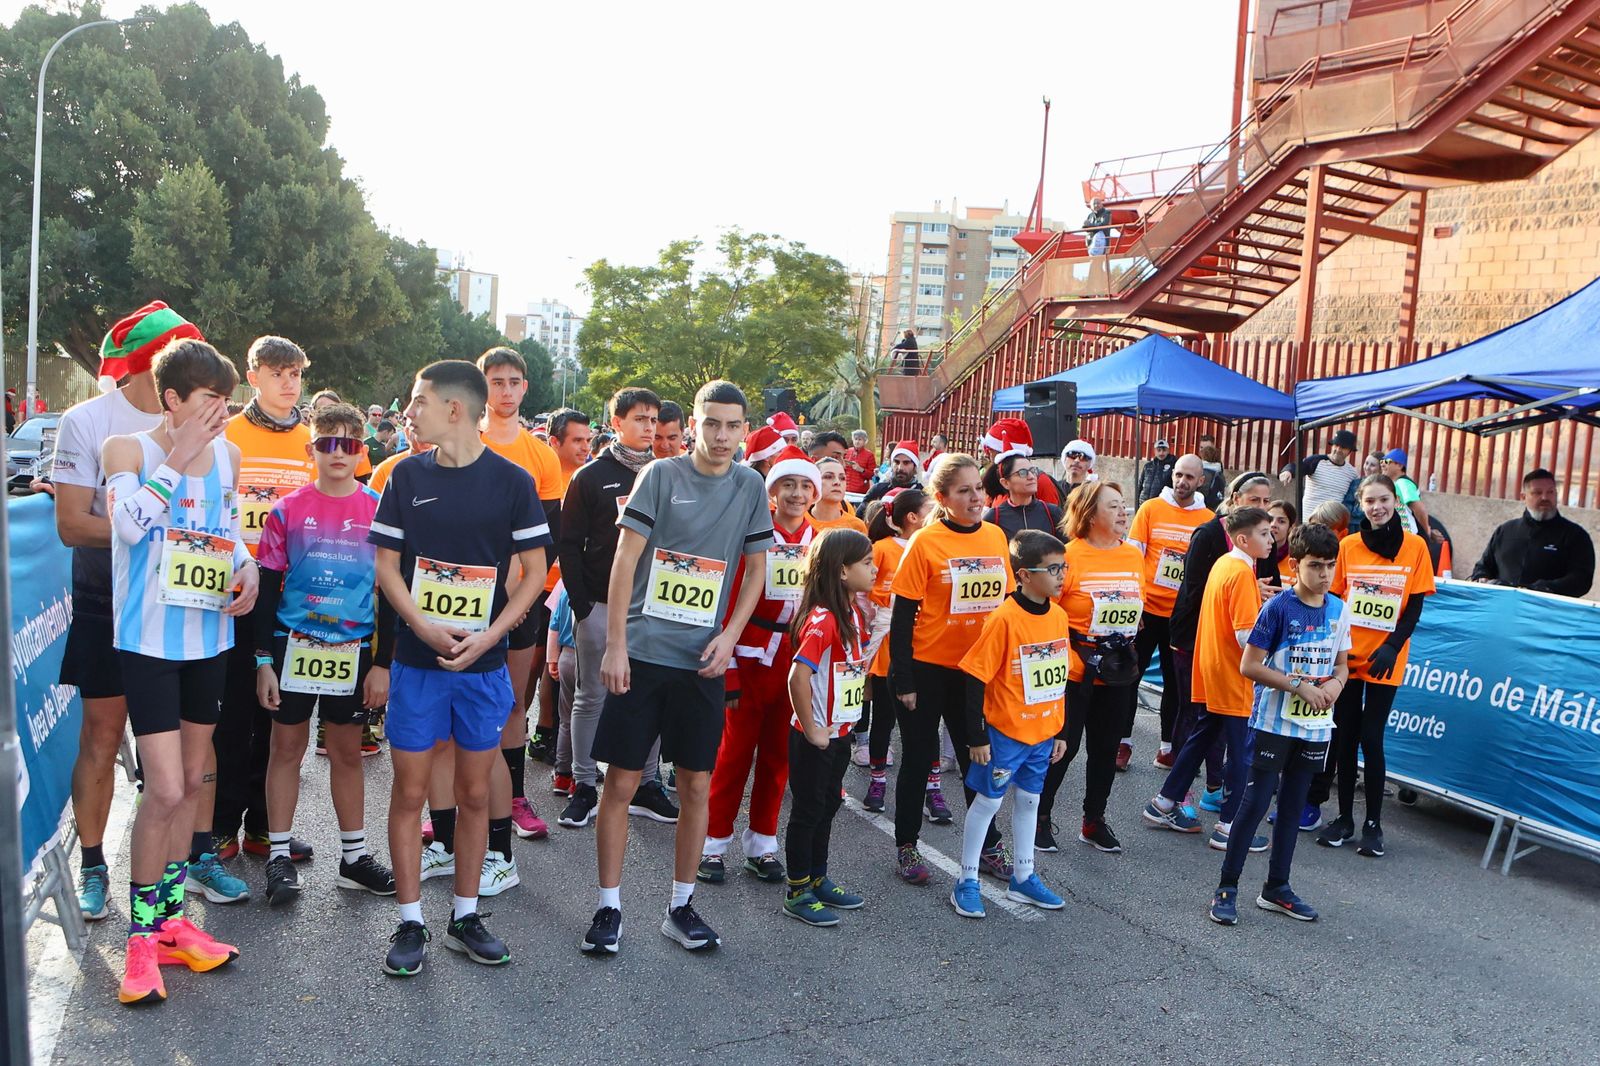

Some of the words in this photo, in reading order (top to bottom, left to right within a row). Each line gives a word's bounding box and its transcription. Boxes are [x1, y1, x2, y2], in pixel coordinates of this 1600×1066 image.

[174, 563, 226, 592] 1031
[960, 580, 1002, 599] 1029
[421, 591, 483, 617] 1021
[657, 580, 714, 609] 1020
[1099, 610, 1137, 624] 1058
[1353, 600, 1394, 619] 1050
[294, 657, 351, 680] 1035
[1033, 665, 1067, 688] 1032
[1490, 676, 1525, 712] de
[1387, 708, 1446, 740] eporte
